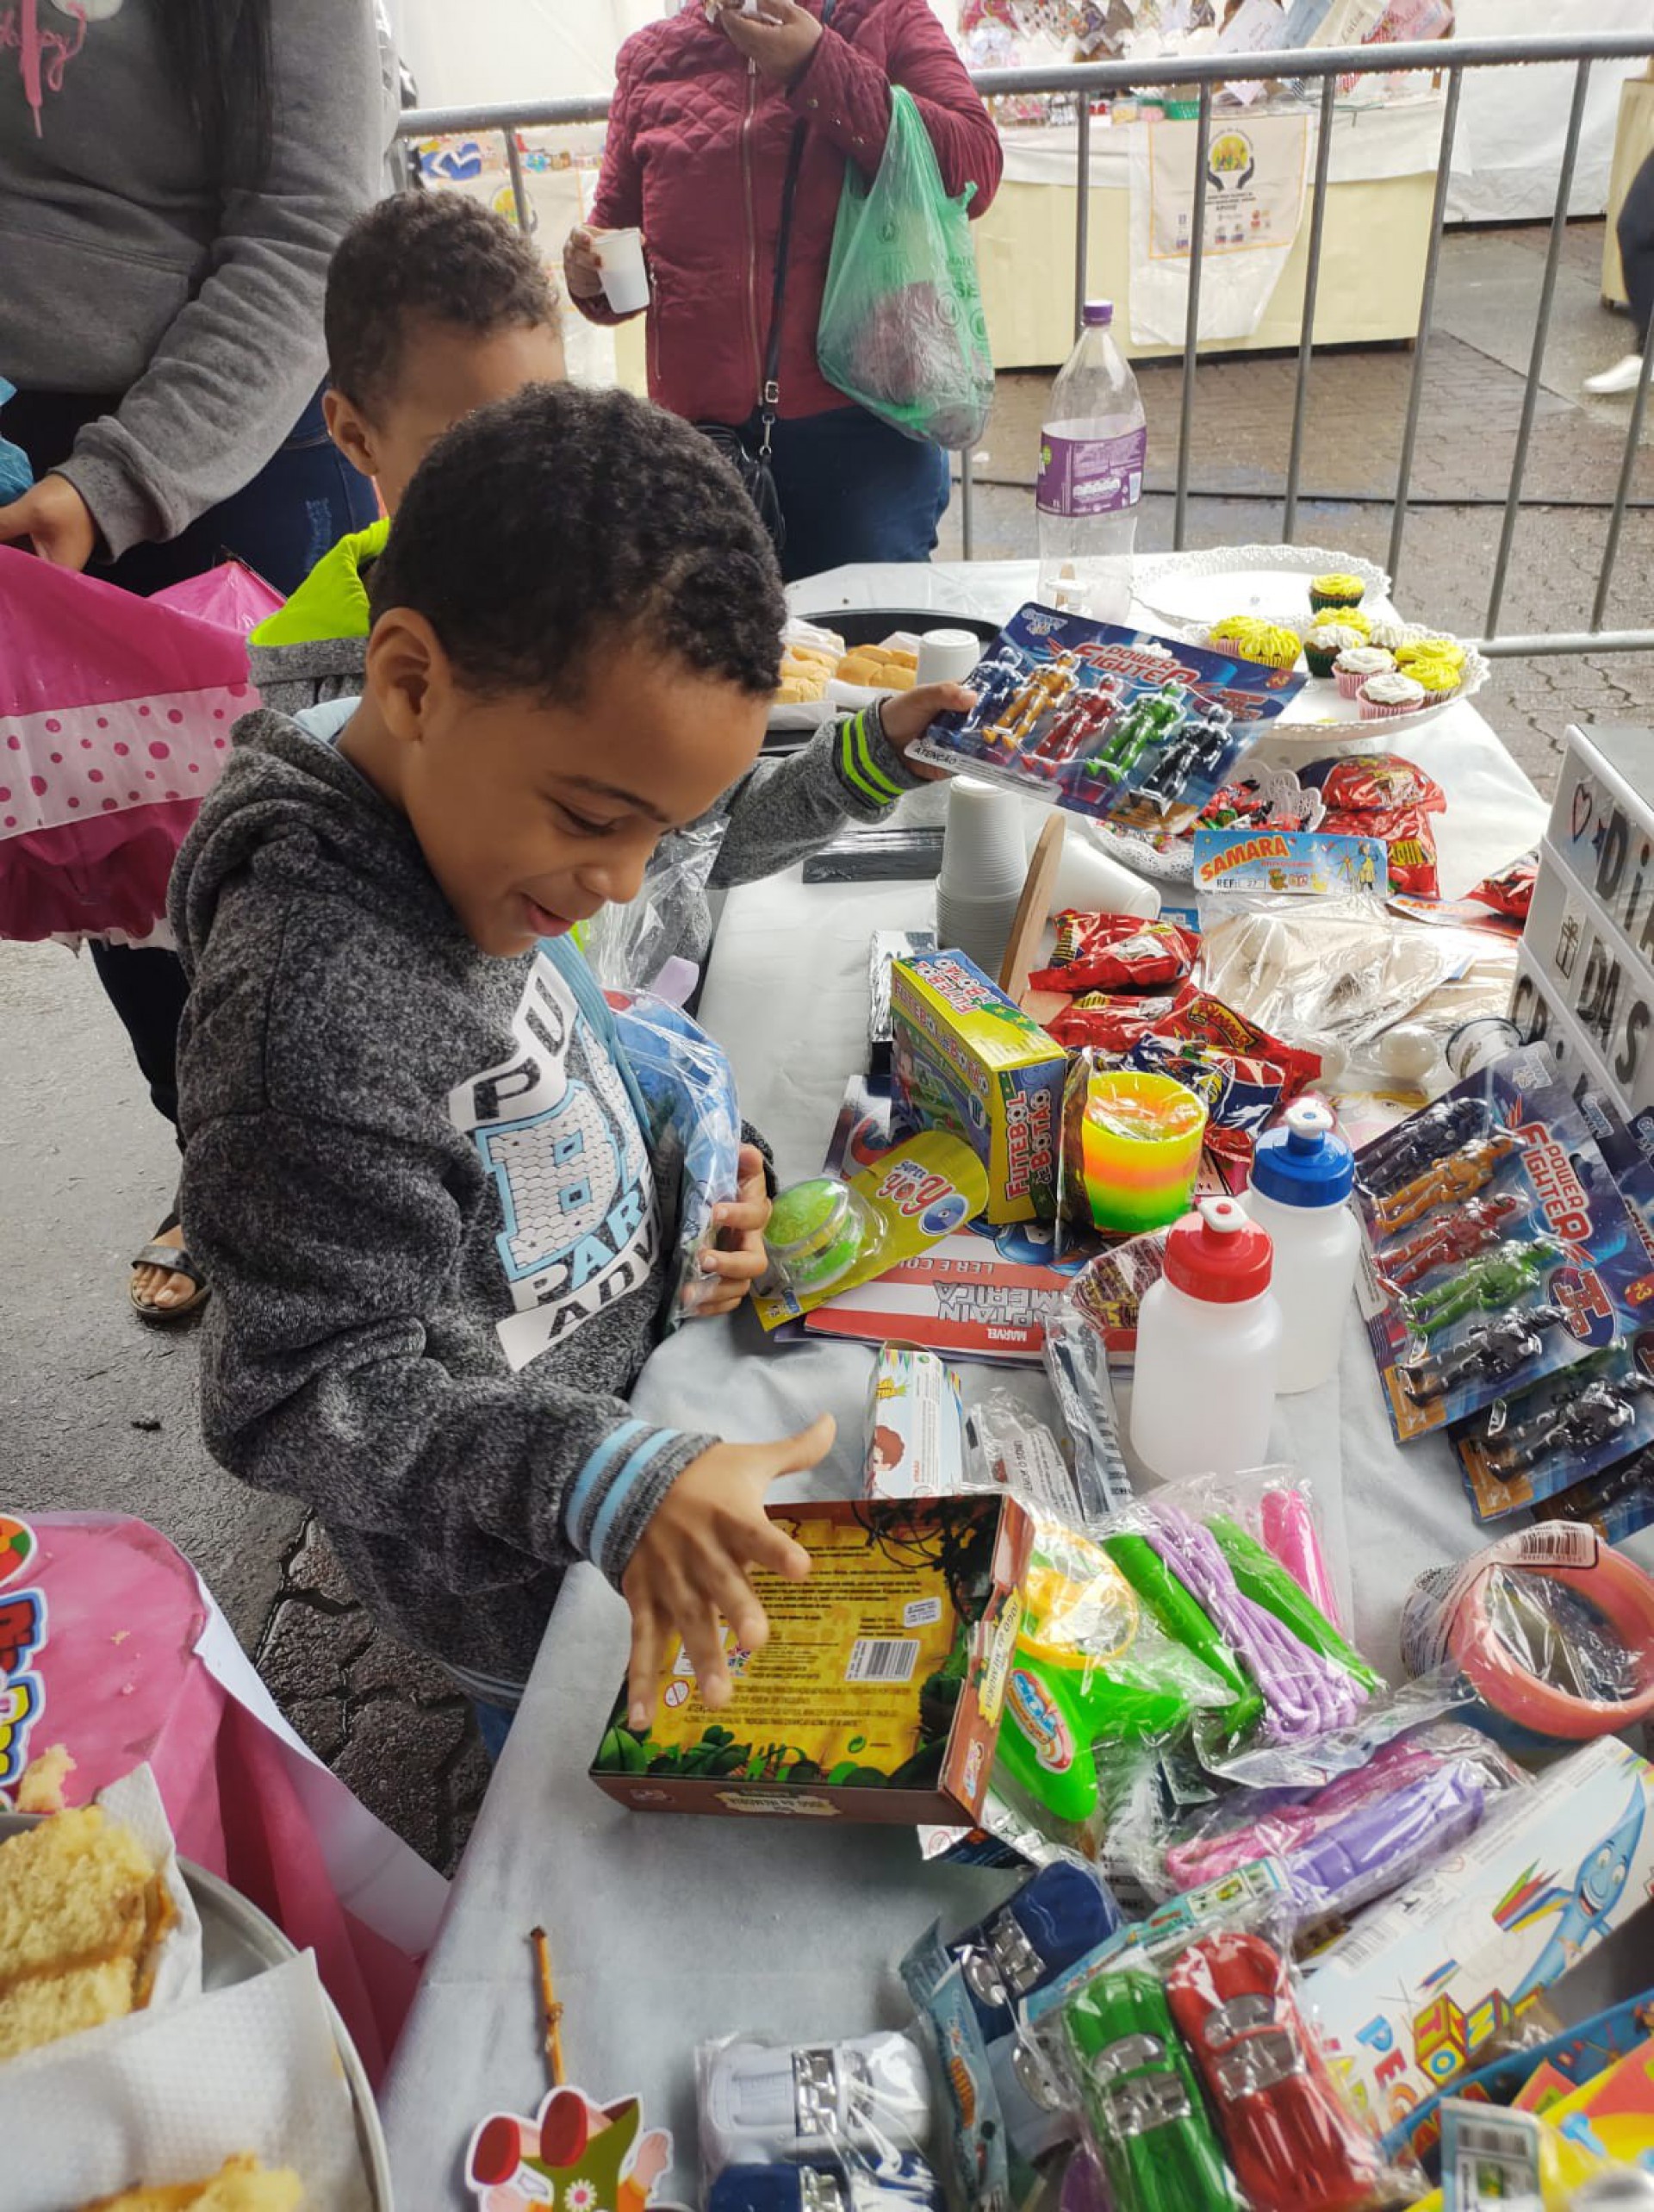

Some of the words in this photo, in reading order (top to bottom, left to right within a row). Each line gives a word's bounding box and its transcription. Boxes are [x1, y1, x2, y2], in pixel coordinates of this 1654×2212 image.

[1074, 643, 1201, 684] FIGHTER
[1110, 645, 1177, 670] POWER
[1198, 834, 1290, 882] SAMARA
[914, 961, 980, 1015] FUTEBOL
[472, 975, 566, 1120] PU
[1005, 1089, 1031, 1201] FUTEBOL
[1027, 1087, 1052, 1172] BOTÃO
[1517, 1123, 1592, 1240] FIGHTER
[1545, 1144, 1584, 1210] POWER
[939, 1259, 951, 1271] E
[956, 1261, 994, 1274] LER
[932, 1280, 1061, 1312] MERICA
[986, 1327, 1028, 1343] MARVEL
